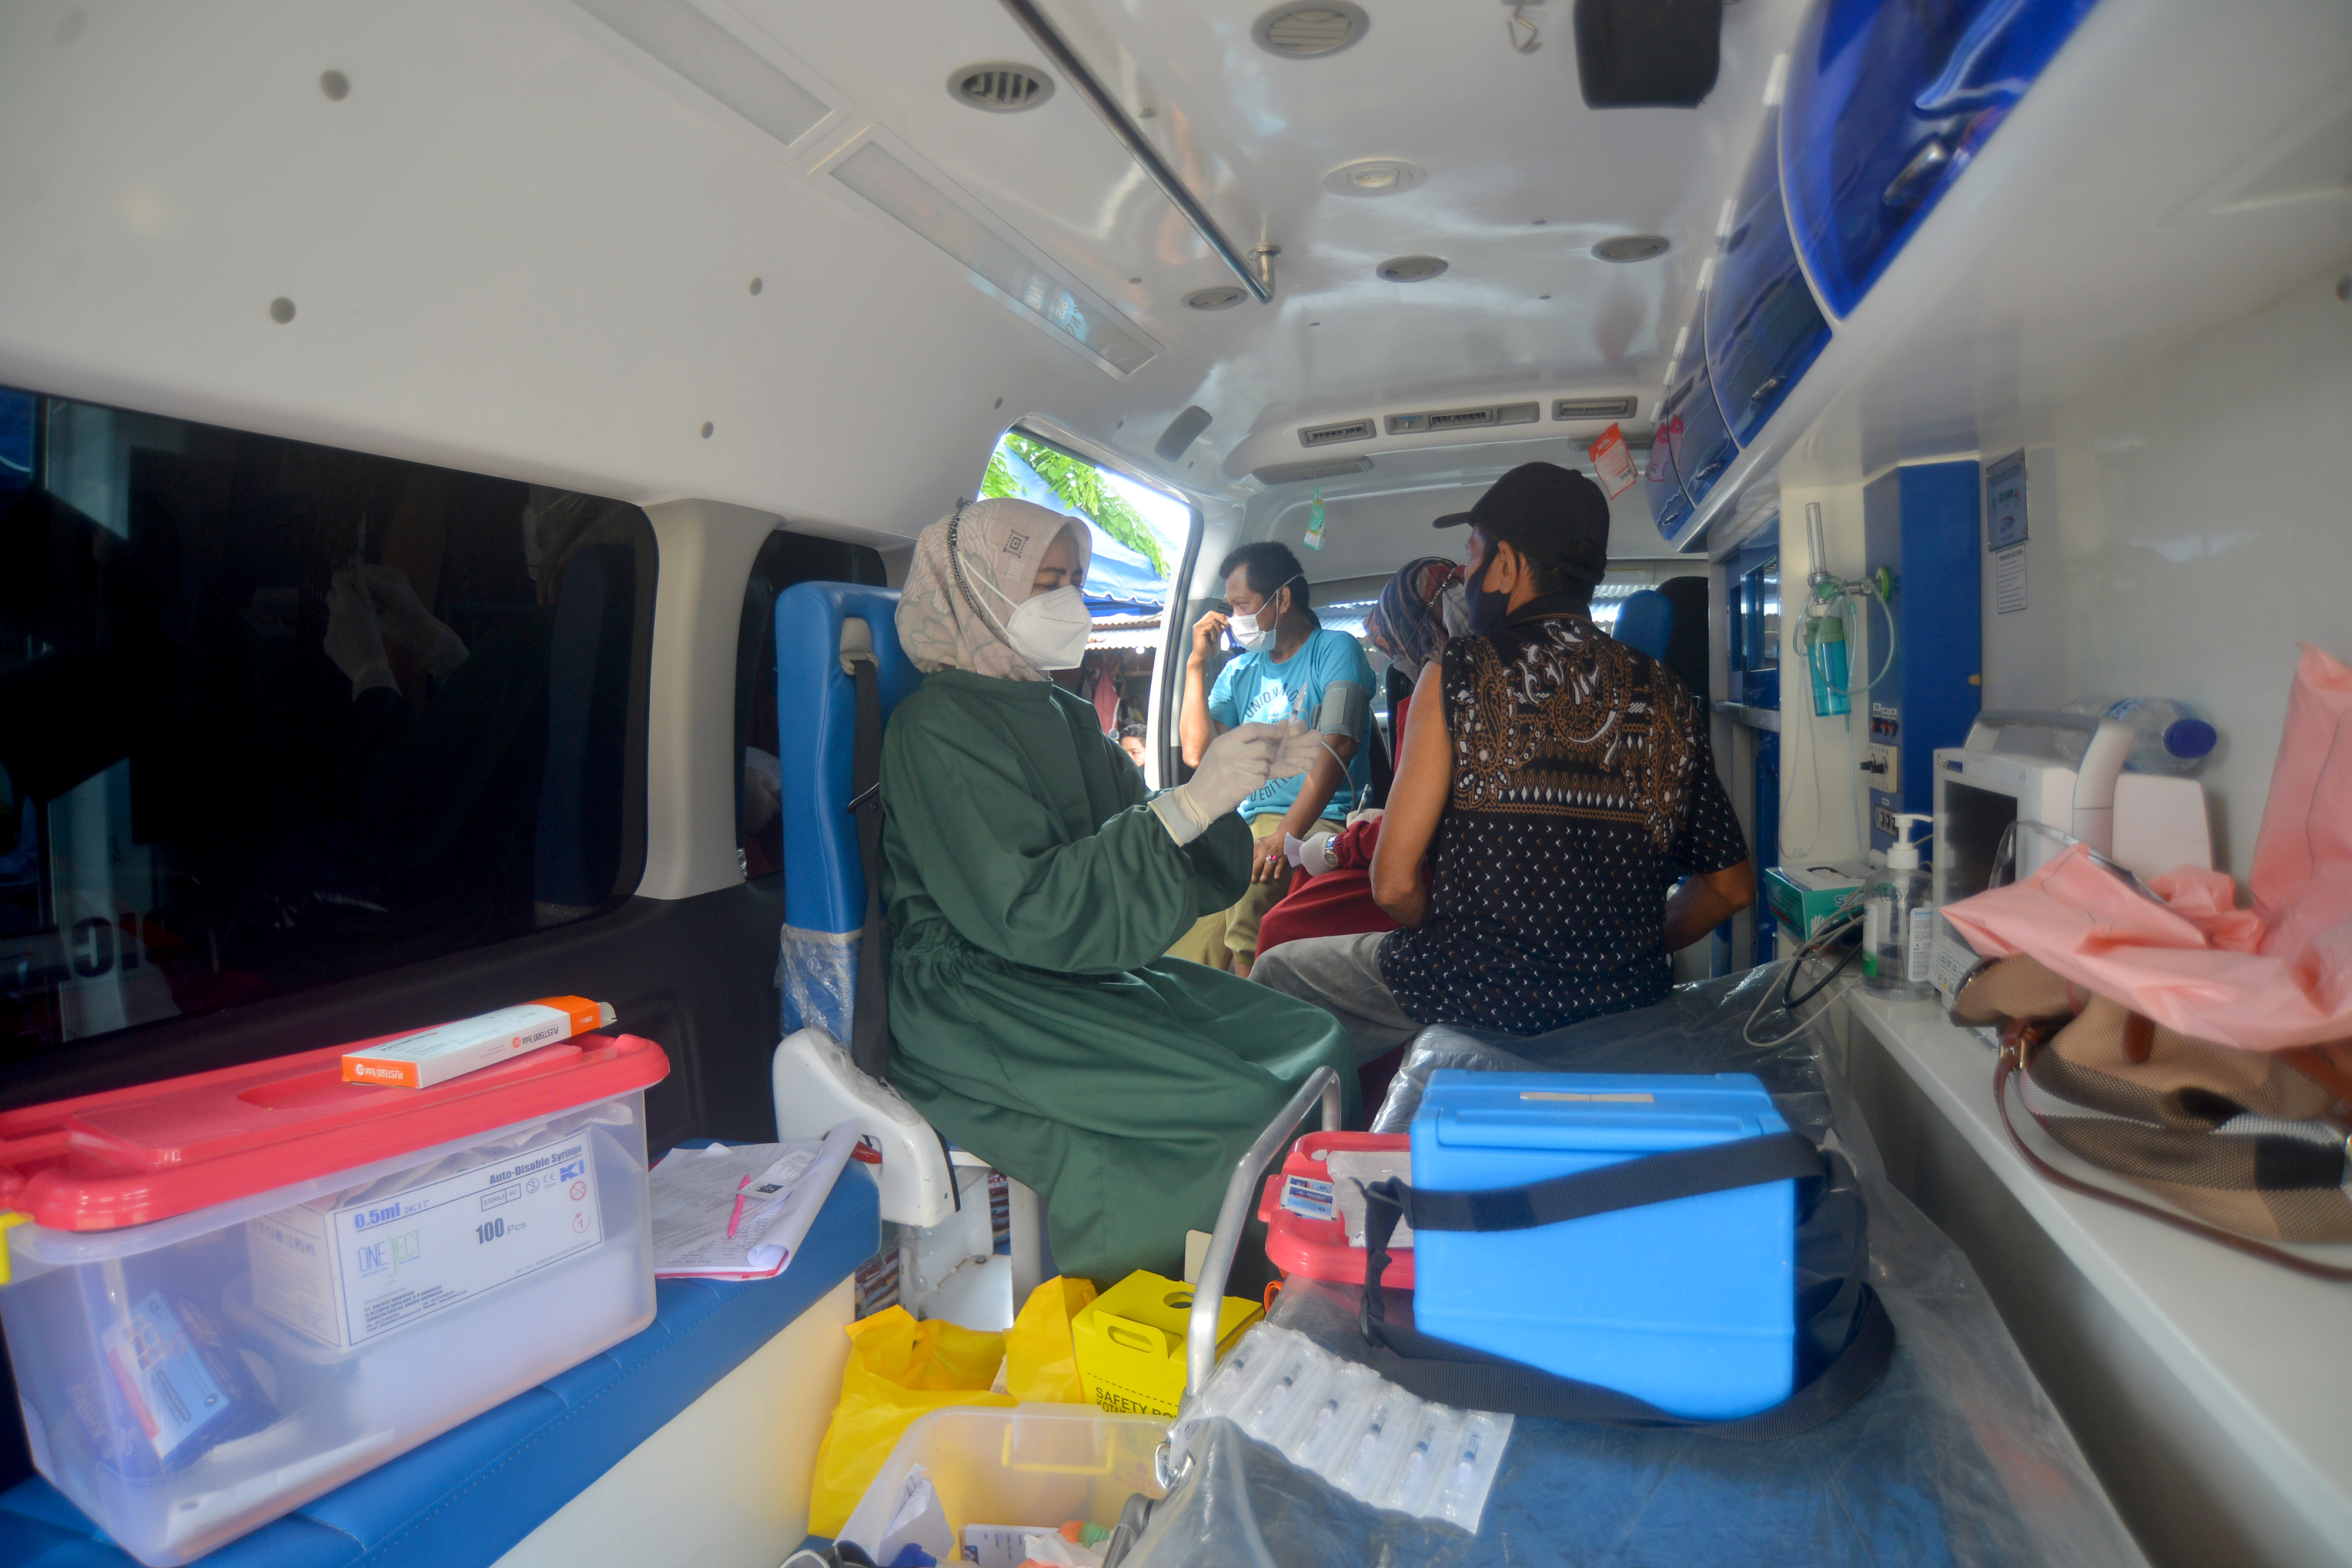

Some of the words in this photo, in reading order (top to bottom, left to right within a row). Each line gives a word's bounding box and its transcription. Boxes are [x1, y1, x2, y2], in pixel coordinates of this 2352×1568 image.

[522, 1035, 533, 1045] Bulat
[533, 1027, 559, 1041] PLESTERIN
[365, 1067, 376, 1077] Bulat
[377, 1069, 404, 1079] PLESTERIN
[490, 1157, 550, 1185] Auto-Disable
[551, 1145, 583, 1162] Syringe
[484, 1193, 505, 1206] STERILE
[355, 1202, 401, 1229] 0.5ml
[405, 1204, 417, 1214] 24G
[476, 1218, 505, 1245] 100
[507, 1222, 527, 1233] Pcs
[1096, 1387, 1147, 1414] SAFETY
